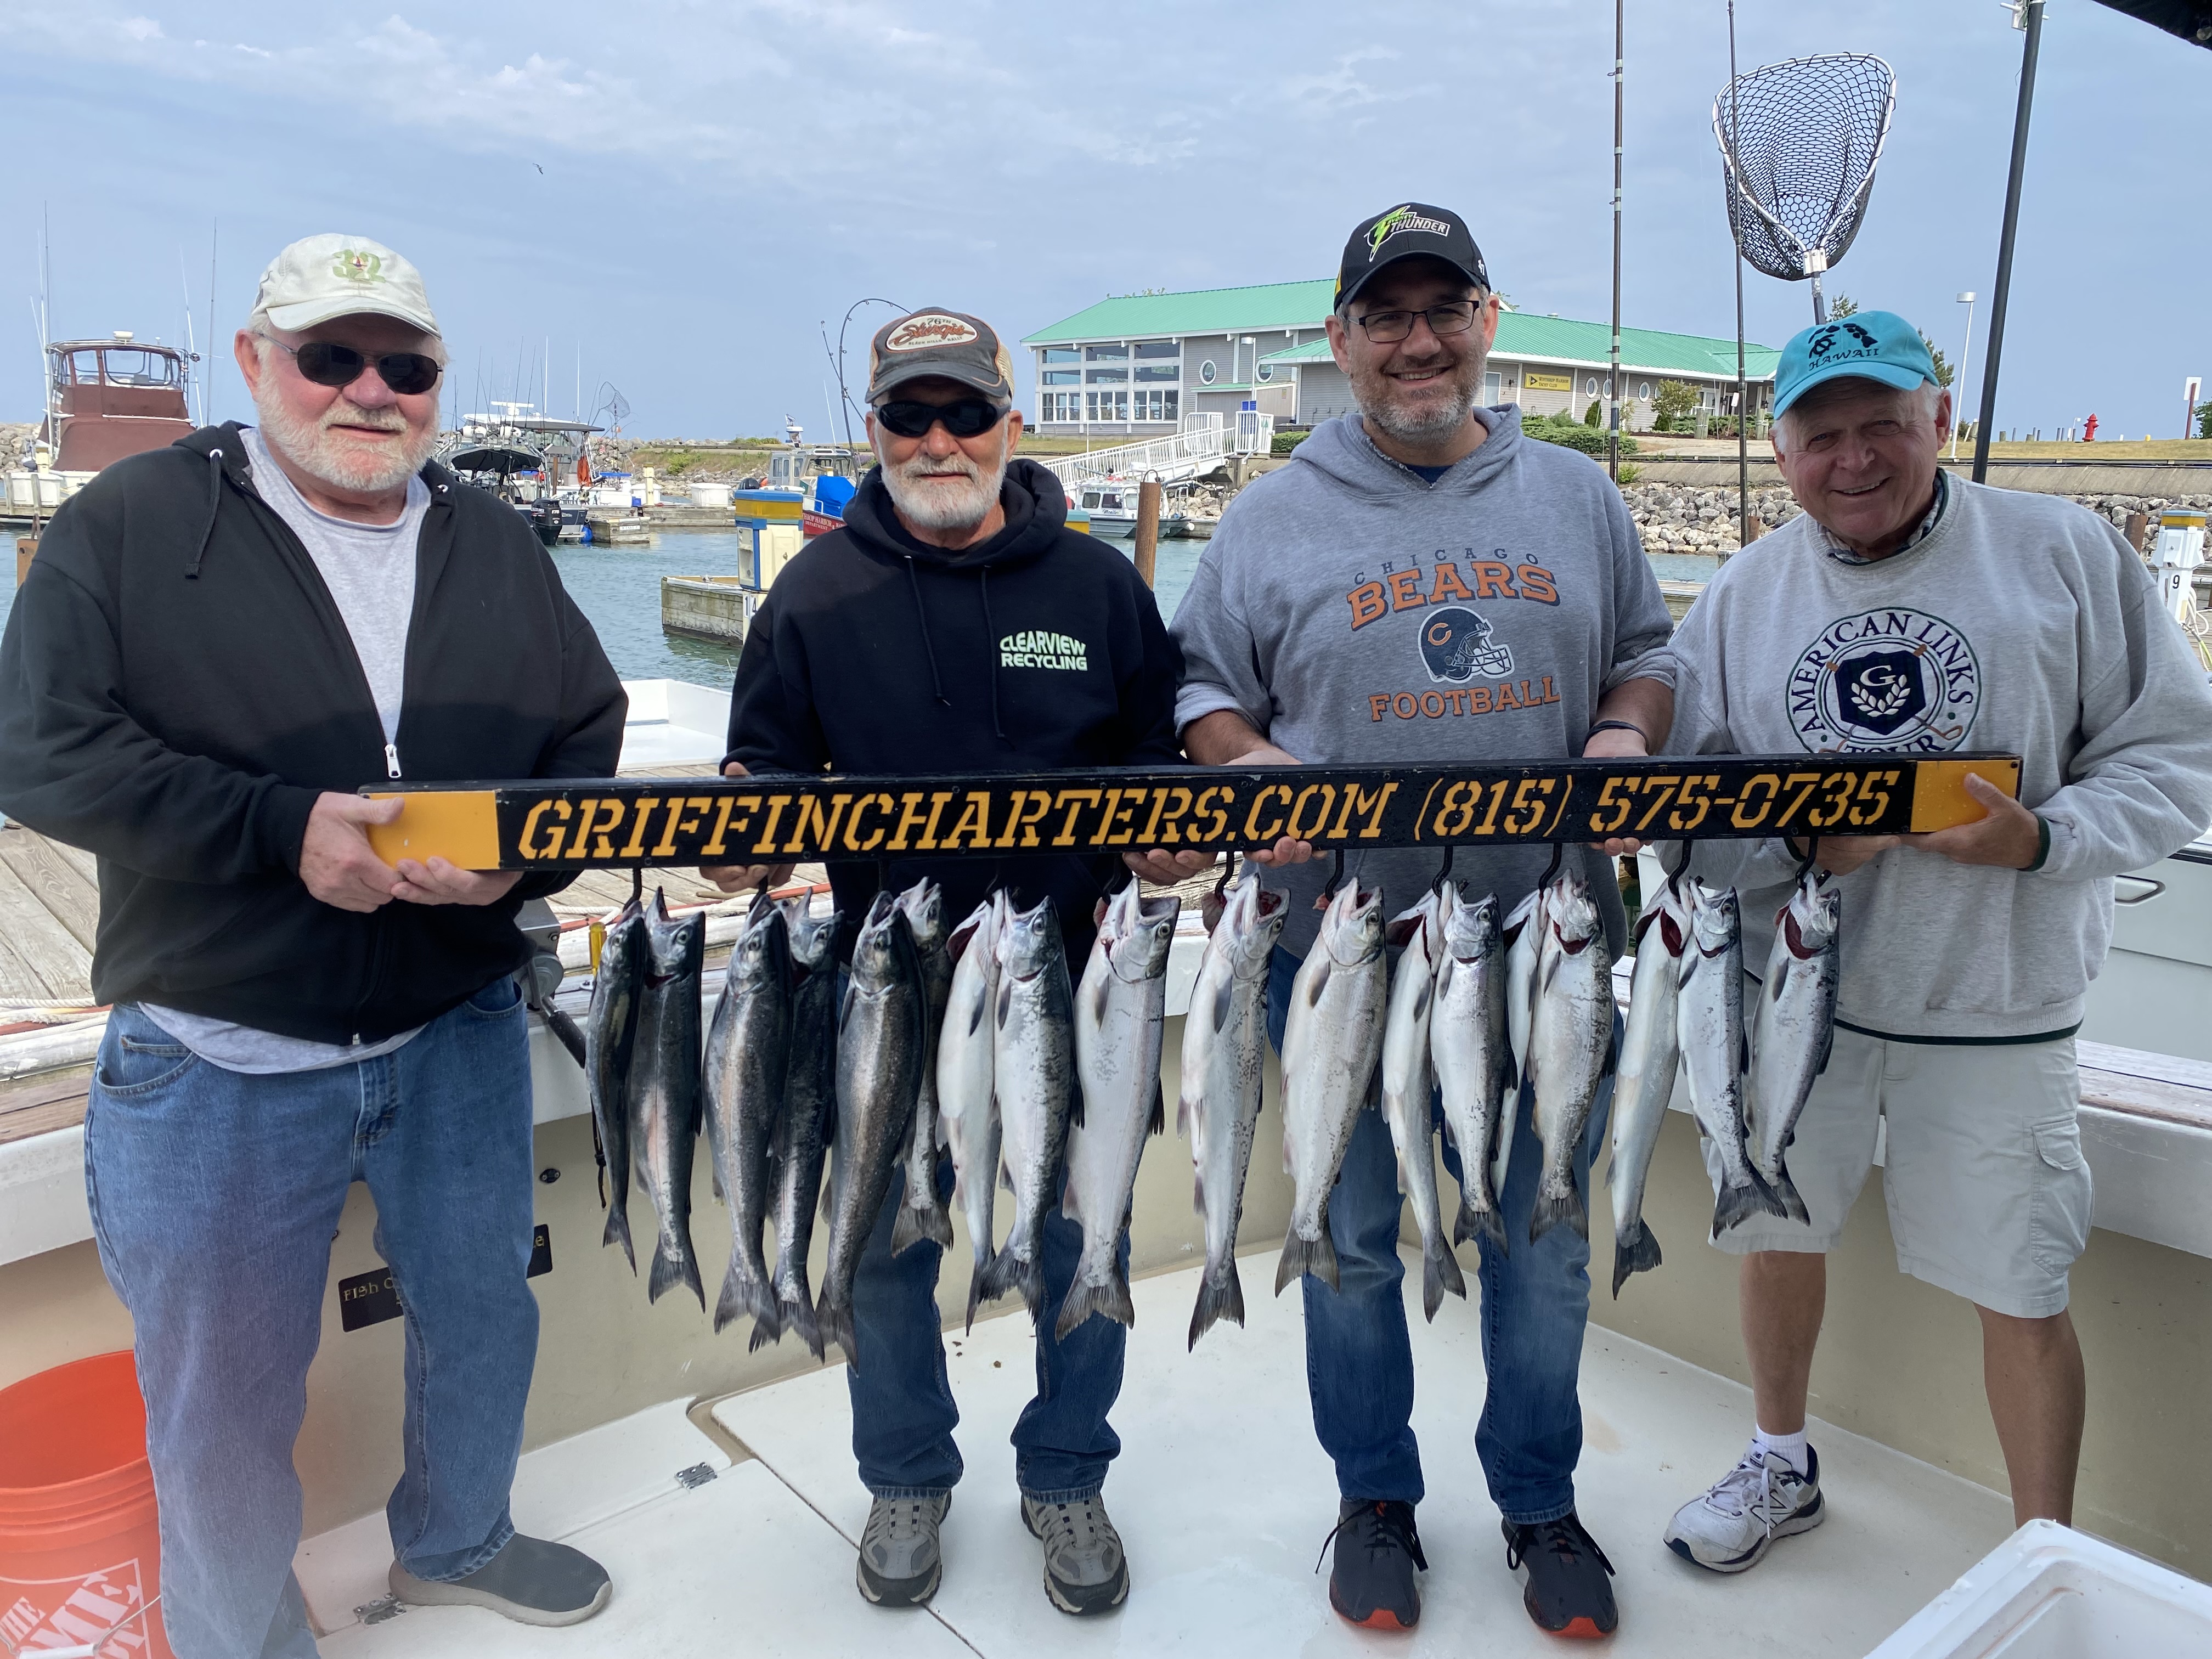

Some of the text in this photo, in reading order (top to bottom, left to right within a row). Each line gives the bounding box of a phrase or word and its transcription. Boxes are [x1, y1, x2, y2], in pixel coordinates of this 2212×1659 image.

[1390, 218, 1446, 233] THUNDER
[1809, 348, 1880, 371] HAWAII
[815, 516, 832, 527] HARBOR
[1354, 547, 1538, 586] CHICAGO
[2172, 574, 2180, 589] 9
[1346, 561, 1561, 631] BEARS
[999, 630, 1086, 656] CLEARVIEW
[1001, 652, 1088, 672] RECYCLING
[1791, 612, 1974, 733] AMERICAN LINKS
[1860, 664, 1897, 687] G
[1369, 676, 1561, 722] FOOTBALL
[518, 771, 1901, 860] GRIFFINCHARTERS.COM (815) 575-0735
